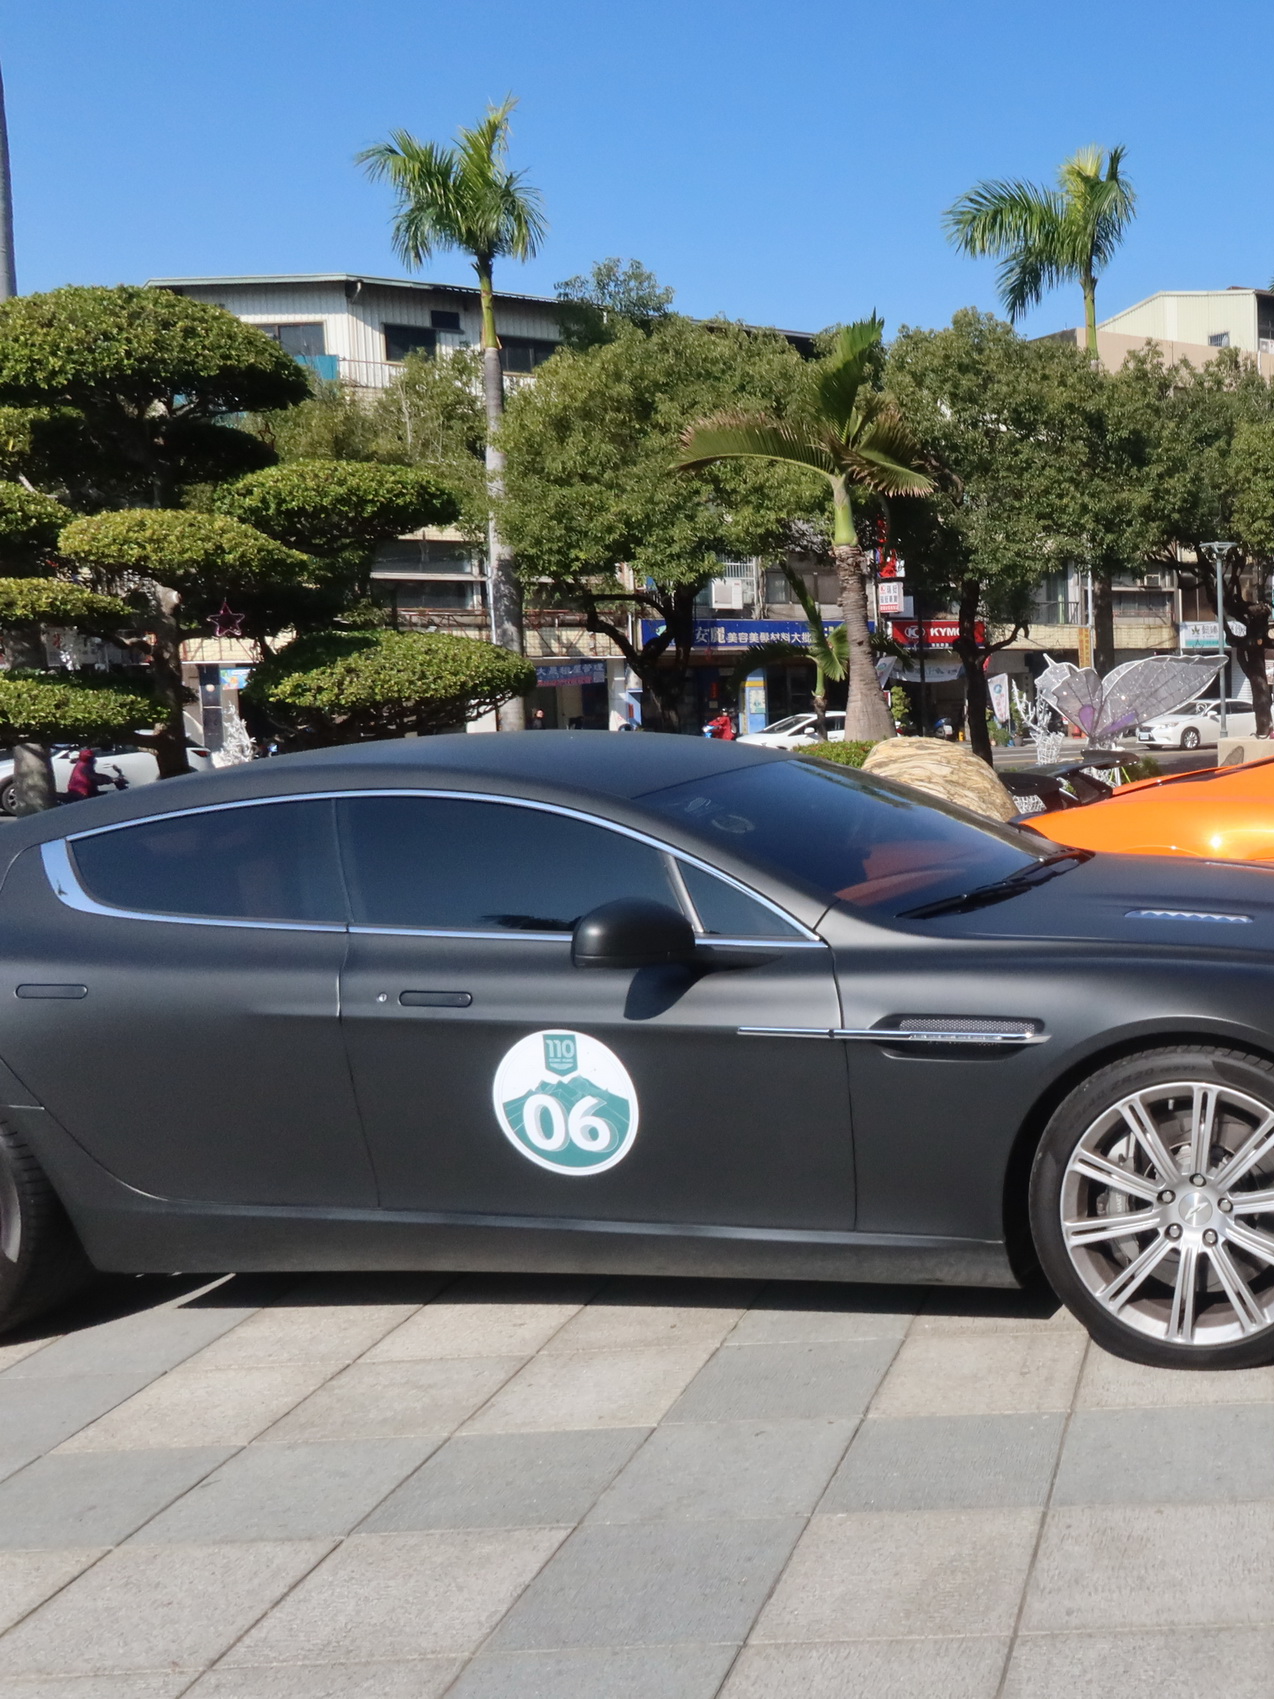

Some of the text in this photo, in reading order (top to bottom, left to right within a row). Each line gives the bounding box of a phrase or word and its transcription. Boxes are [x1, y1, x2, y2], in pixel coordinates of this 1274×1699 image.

[727, 632, 818, 644] 美容美髮材料大批
[546, 1040, 575, 1058] 110
[523, 1094, 615, 1152] 06
